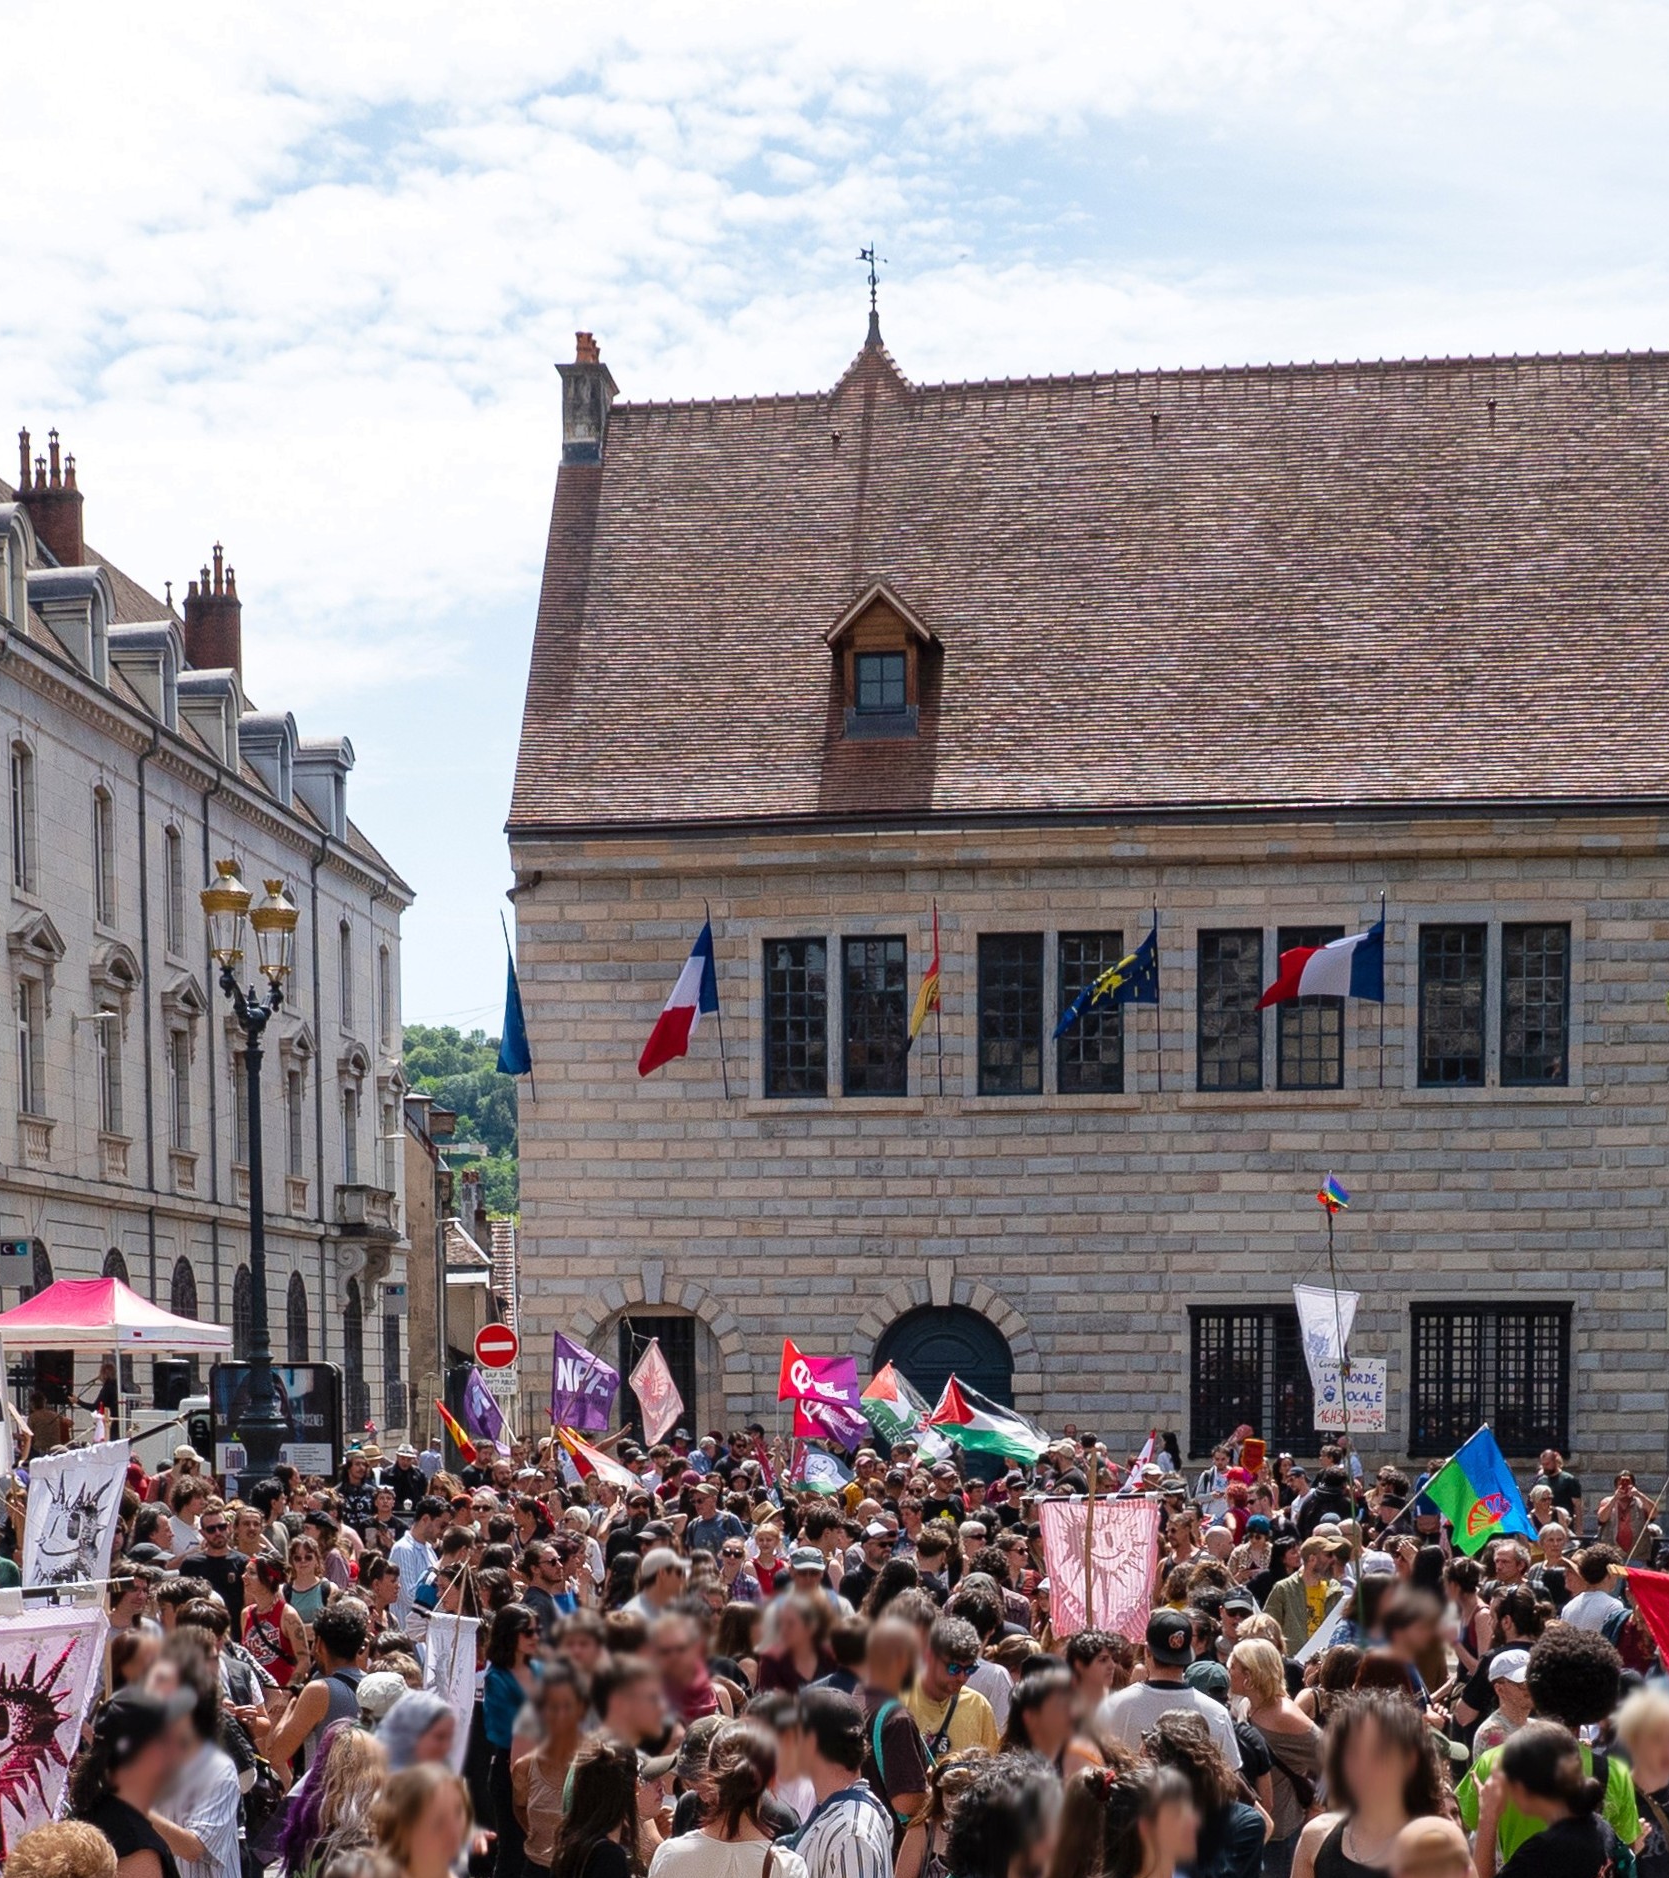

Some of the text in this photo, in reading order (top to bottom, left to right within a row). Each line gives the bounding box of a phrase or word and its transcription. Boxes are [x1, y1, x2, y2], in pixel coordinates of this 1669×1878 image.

[1324, 1372, 1378, 1385] LA HORDE
[863, 1404, 901, 1445] PALES
